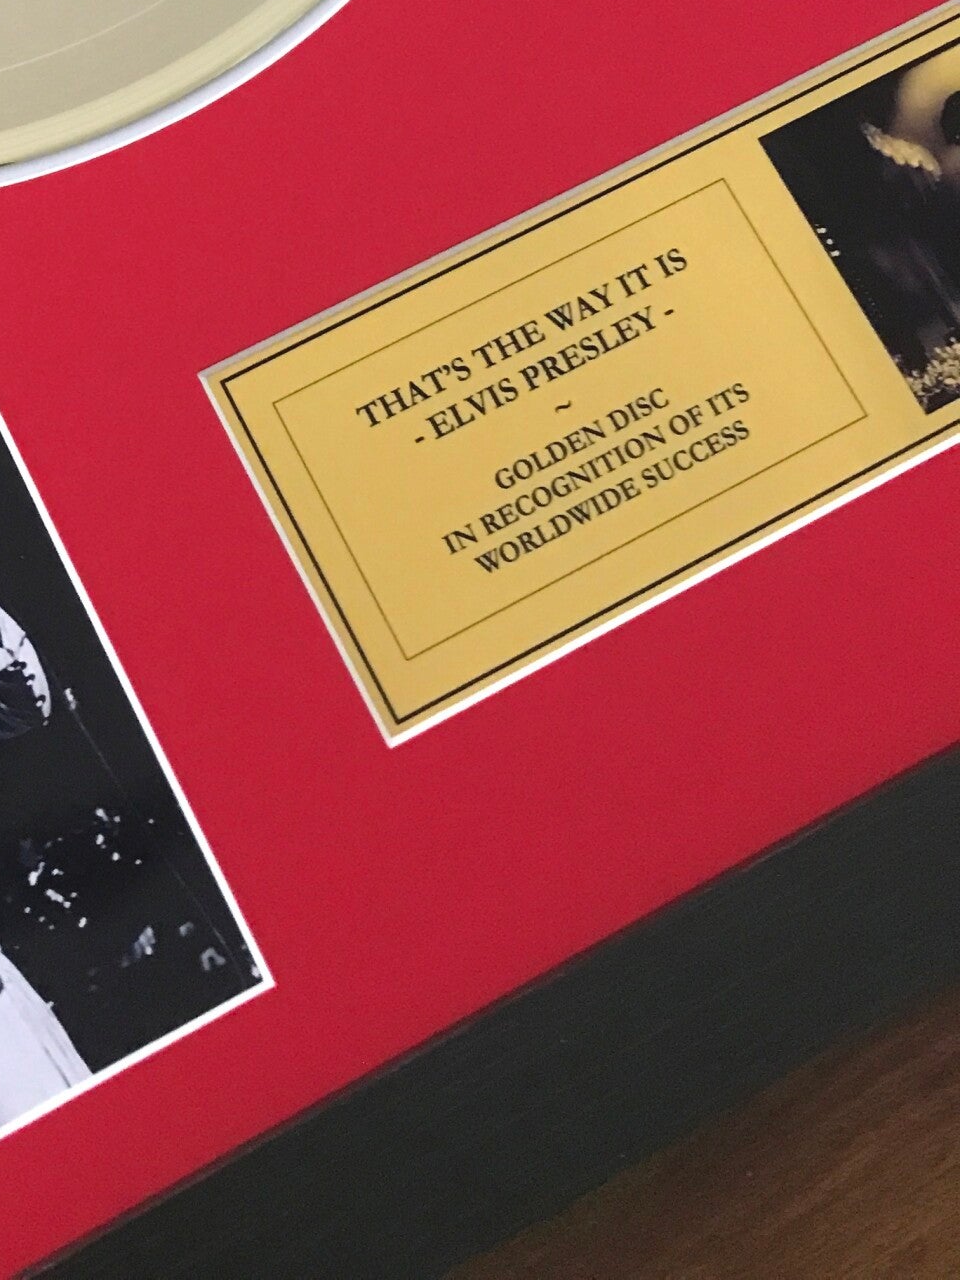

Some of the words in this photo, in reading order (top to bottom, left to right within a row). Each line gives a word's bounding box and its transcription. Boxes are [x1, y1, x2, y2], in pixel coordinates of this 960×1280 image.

[356, 357, 472, 427] THAT'S
[471, 320, 545, 370] THE
[545, 284, 614, 331] WAY
[615, 264, 652, 298] IT
[654, 248, 687, 278] IS
[426, 377, 519, 441] ELVIS
[519, 305, 657, 391] PRESLEY
[442, 524, 479, 554] IN
[480, 424, 666, 535] RECOGNITION
[669, 406, 705, 436] OF
[706, 382, 750, 416] ITS
[474, 477, 642, 574] WORLDWIDE
[645, 420, 750, 488] SUCCESS
[495, 421, 606, 489] GOLDEN
[606, 388, 669, 432] DISC
